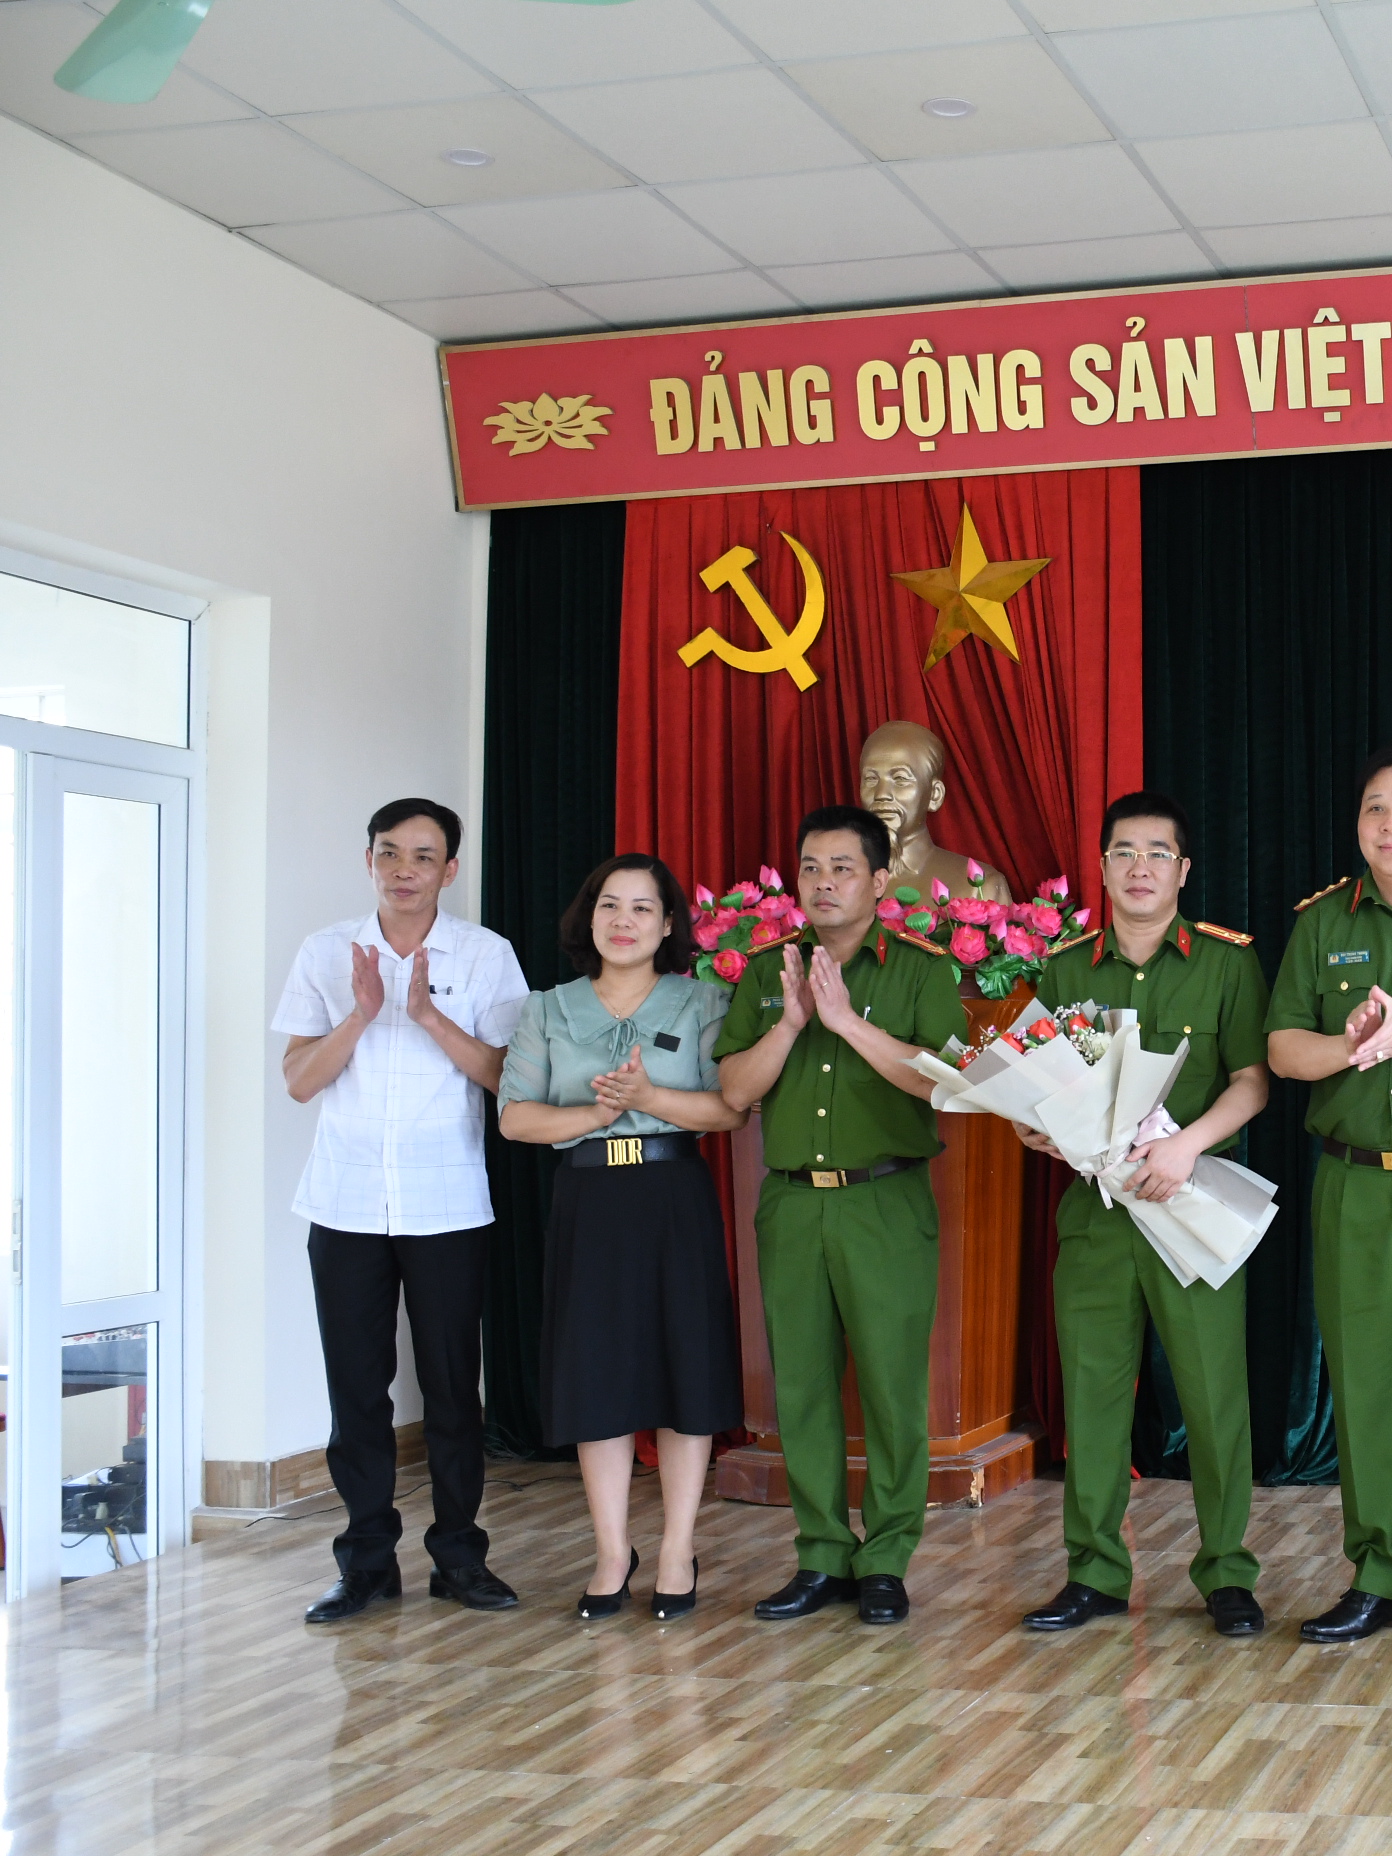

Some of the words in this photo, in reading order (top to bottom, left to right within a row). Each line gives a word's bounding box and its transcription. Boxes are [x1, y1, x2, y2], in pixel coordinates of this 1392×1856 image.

[650, 351, 834, 456] ĐẢNG
[857, 339, 1044, 452] CỘNG
[1070, 317, 1217, 426] SẢN
[1235, 308, 1392, 423] VIỆT
[606, 1137, 643, 1167] DIOR
